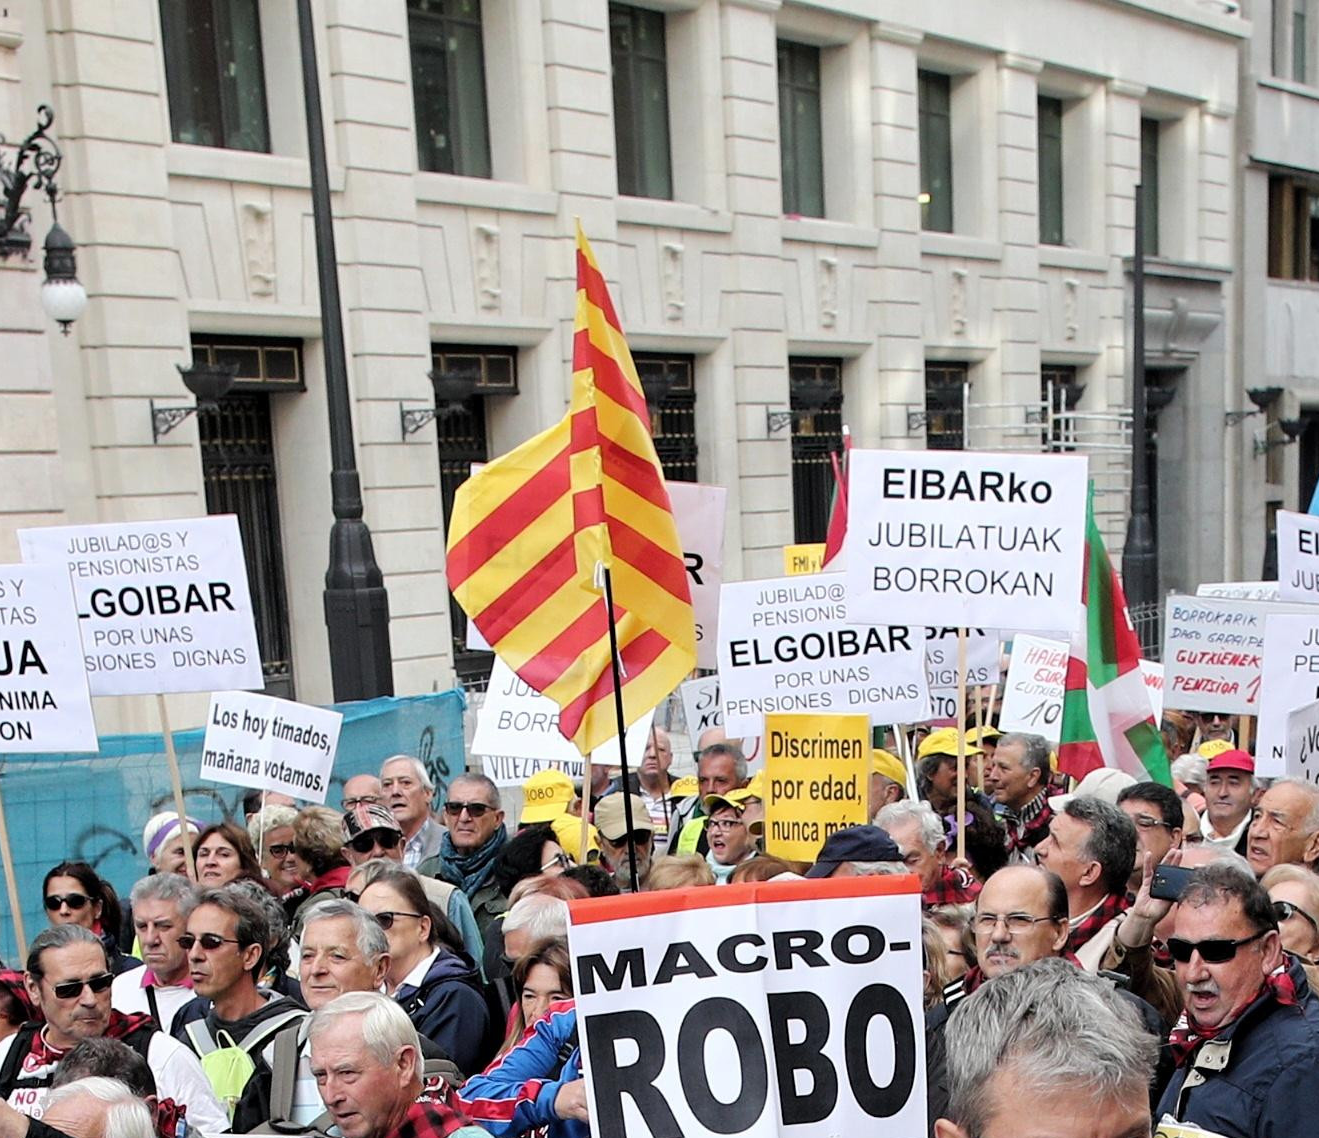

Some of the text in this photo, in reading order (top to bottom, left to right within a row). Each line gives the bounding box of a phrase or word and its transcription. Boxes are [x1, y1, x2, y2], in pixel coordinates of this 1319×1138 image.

[883, 467, 1053, 505] EIBARko
[68, 531, 189, 556] JUBILAD@S Y
[868, 522, 1063, 552] JUBILATUAK
[69, 554, 200, 578] PENSIONISTAS
[9, 578, 25, 599] Y
[873, 566, 1054, 598] BORROKAN
[78, 582, 236, 620] GOIBAR
[752, 604, 847, 628] PENSIONIS
[94, 626, 193, 649] POR UNAS
[730, 626, 912, 668] ELGOIBAR
[85, 647, 247, 672] SIONES DIGNAS
[775, 666, 871, 689] POR UNAS
[726, 684, 920, 716] PENSIONES DIGNAS
[212, 703, 332, 757] Los hoy timados,
[771, 731, 863, 760] Discrimen
[203, 745, 325, 795] mañana votamos.
[771, 775, 863, 807] por edad,
[772, 820, 820, 841] nunca
[576, 924, 911, 995] MACRO-
[15, 1091, 37, 1105] NO
